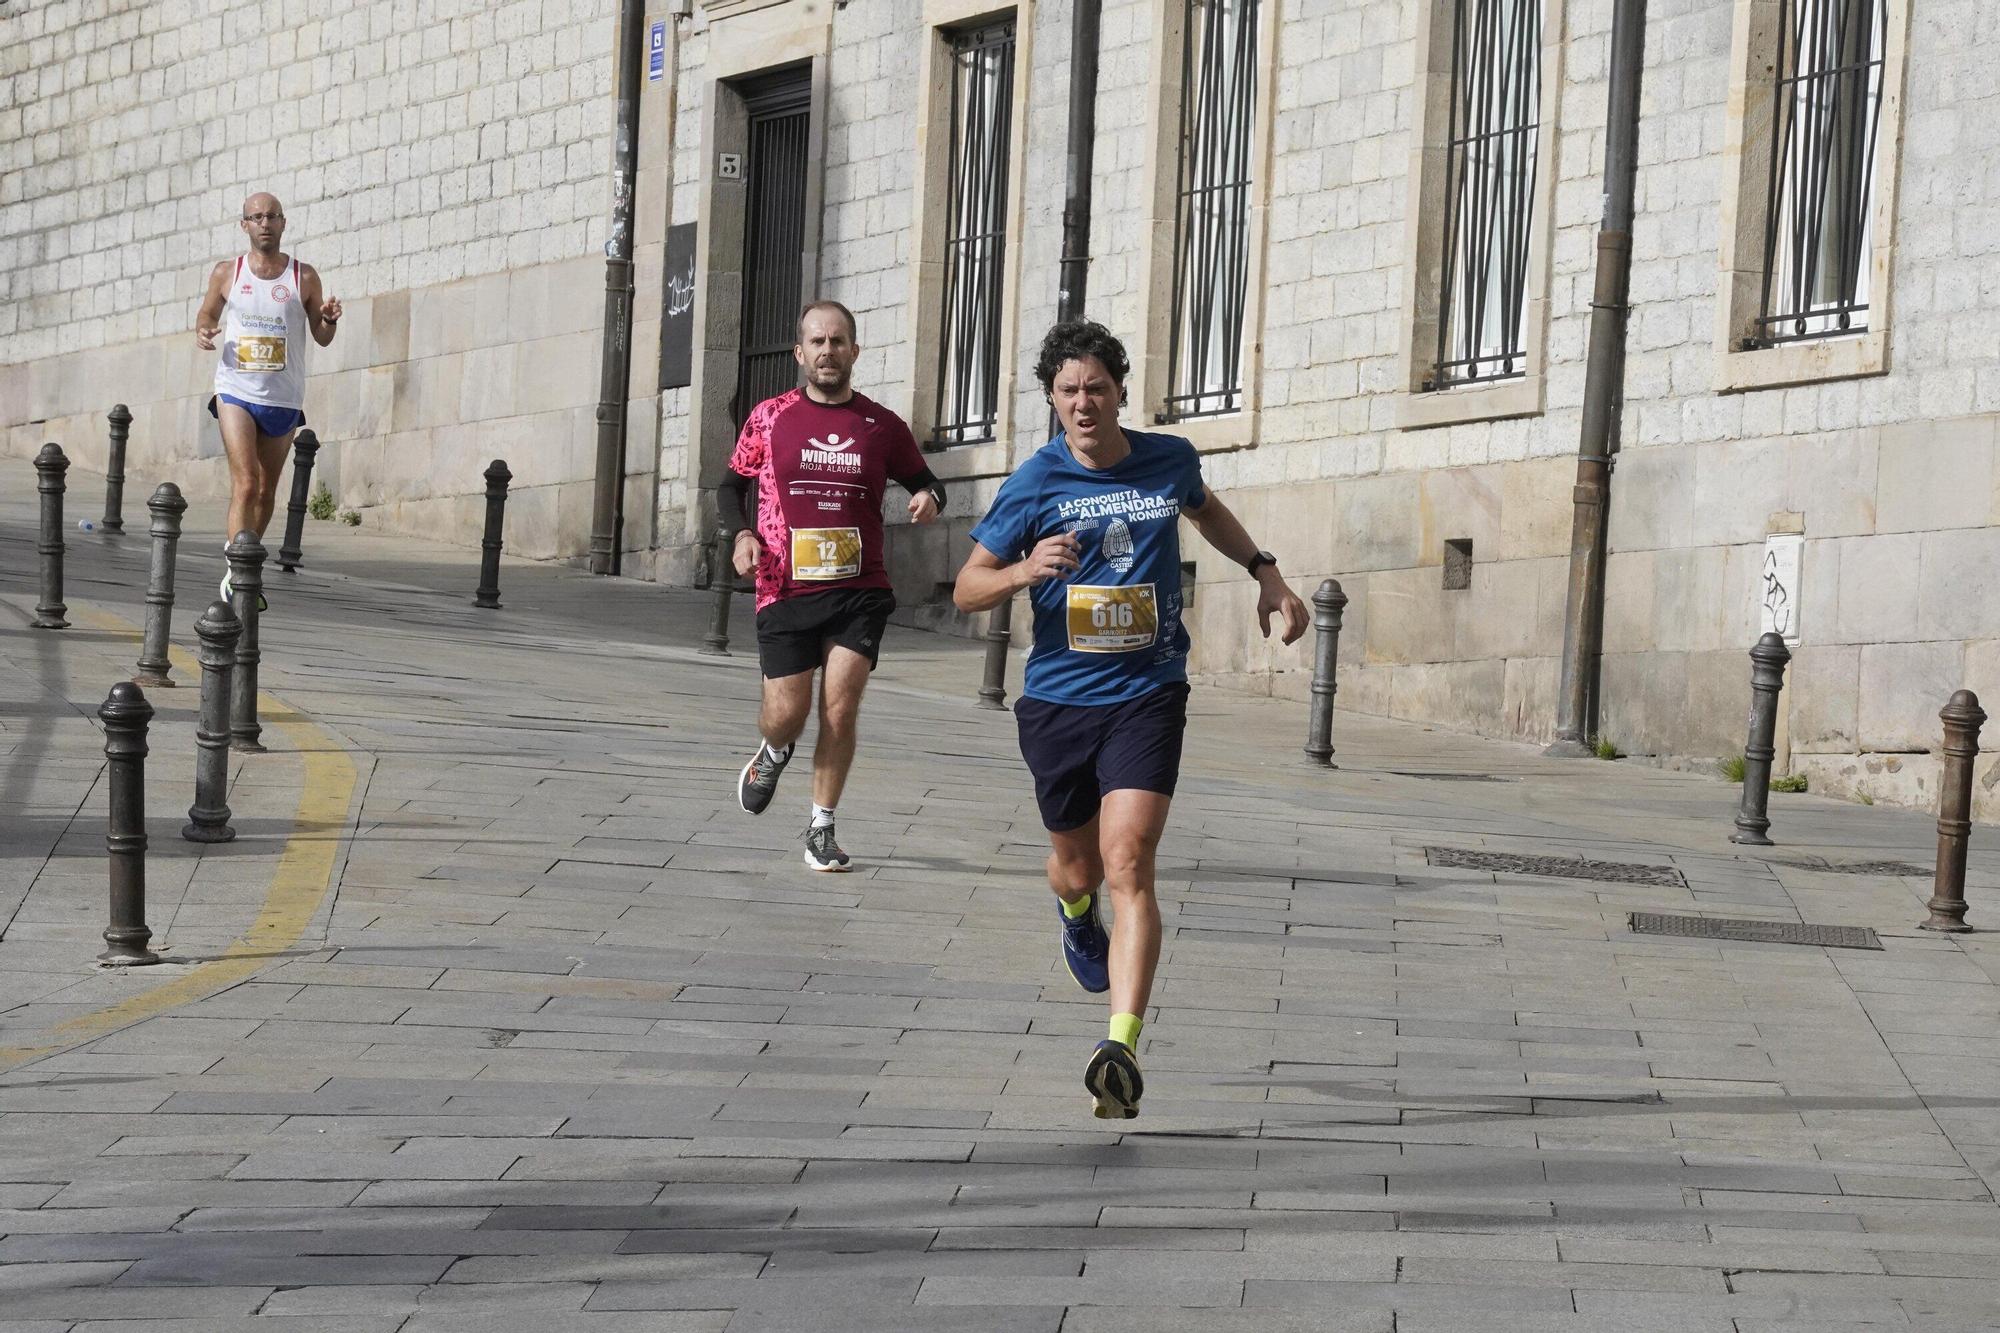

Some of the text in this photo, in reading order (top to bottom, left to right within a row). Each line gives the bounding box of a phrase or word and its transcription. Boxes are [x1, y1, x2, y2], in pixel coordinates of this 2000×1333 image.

[723, 157, 737, 175] 5
[241, 313, 273, 322] Farmacia
[250, 344, 274, 359] 527
[800, 462, 862, 474] RIOJA ALAVESA
[1058, 489, 1141, 512] LA CONQUISTA
[1060, 510, 1071, 518] DE
[1070, 508, 1080, 516] LA
[1079, 495, 1168, 520] ALMENDRA
[1127, 505, 1180, 523] KONKISTA
[817, 541, 837, 560] 12
[1092, 602, 1133, 628] 616
